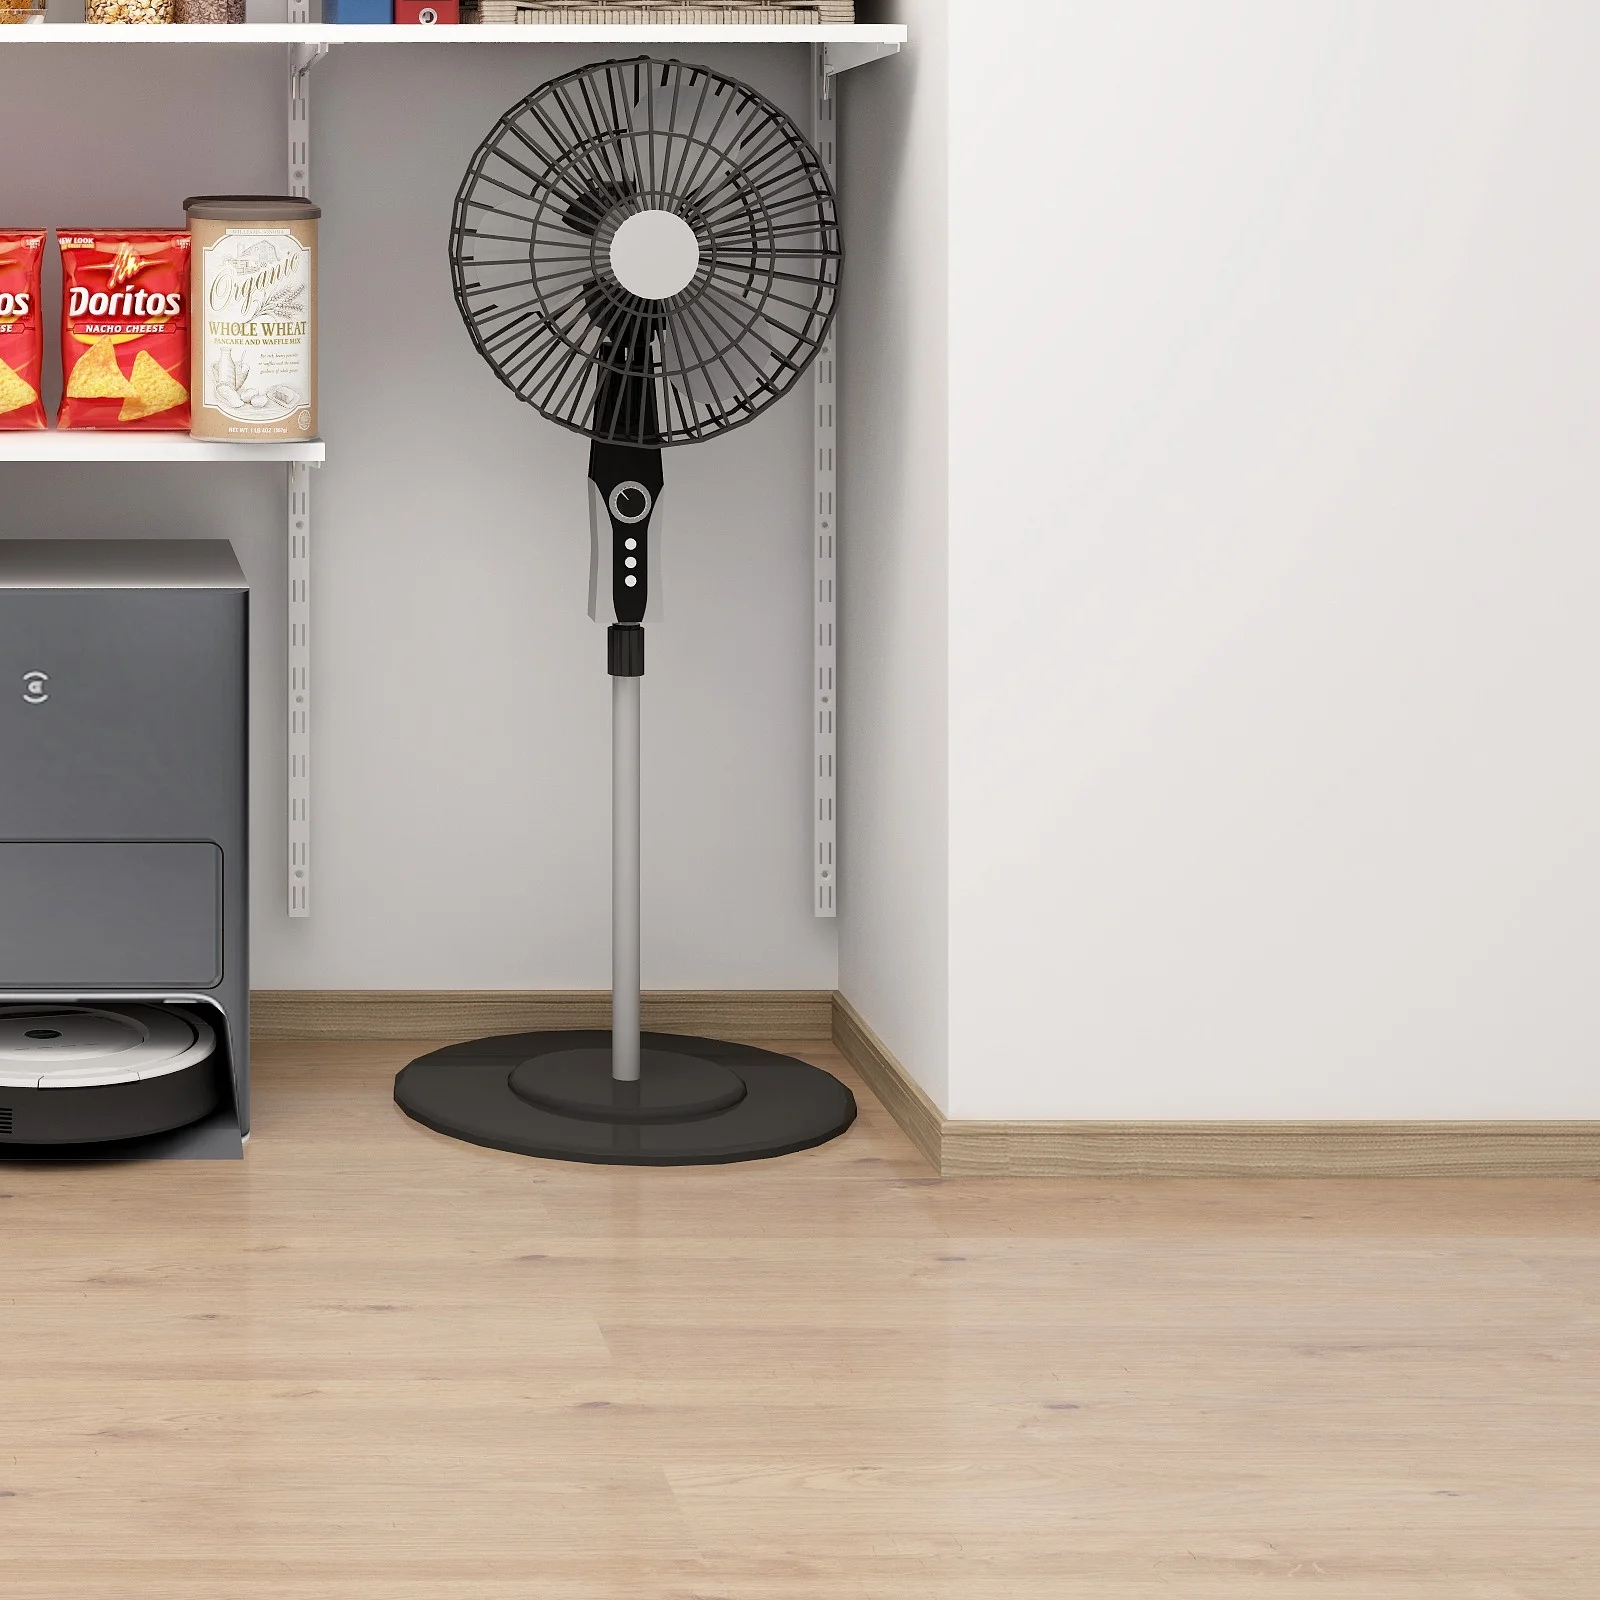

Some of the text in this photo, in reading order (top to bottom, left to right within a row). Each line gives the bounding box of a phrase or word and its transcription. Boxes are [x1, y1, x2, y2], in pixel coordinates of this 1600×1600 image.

[209, 251, 299, 317] Organic
[69, 285, 181, 317] Doritos
[85, 324, 165, 333] NACHO CHEESE
[208, 321, 307, 337] WHOLE WHEAT
